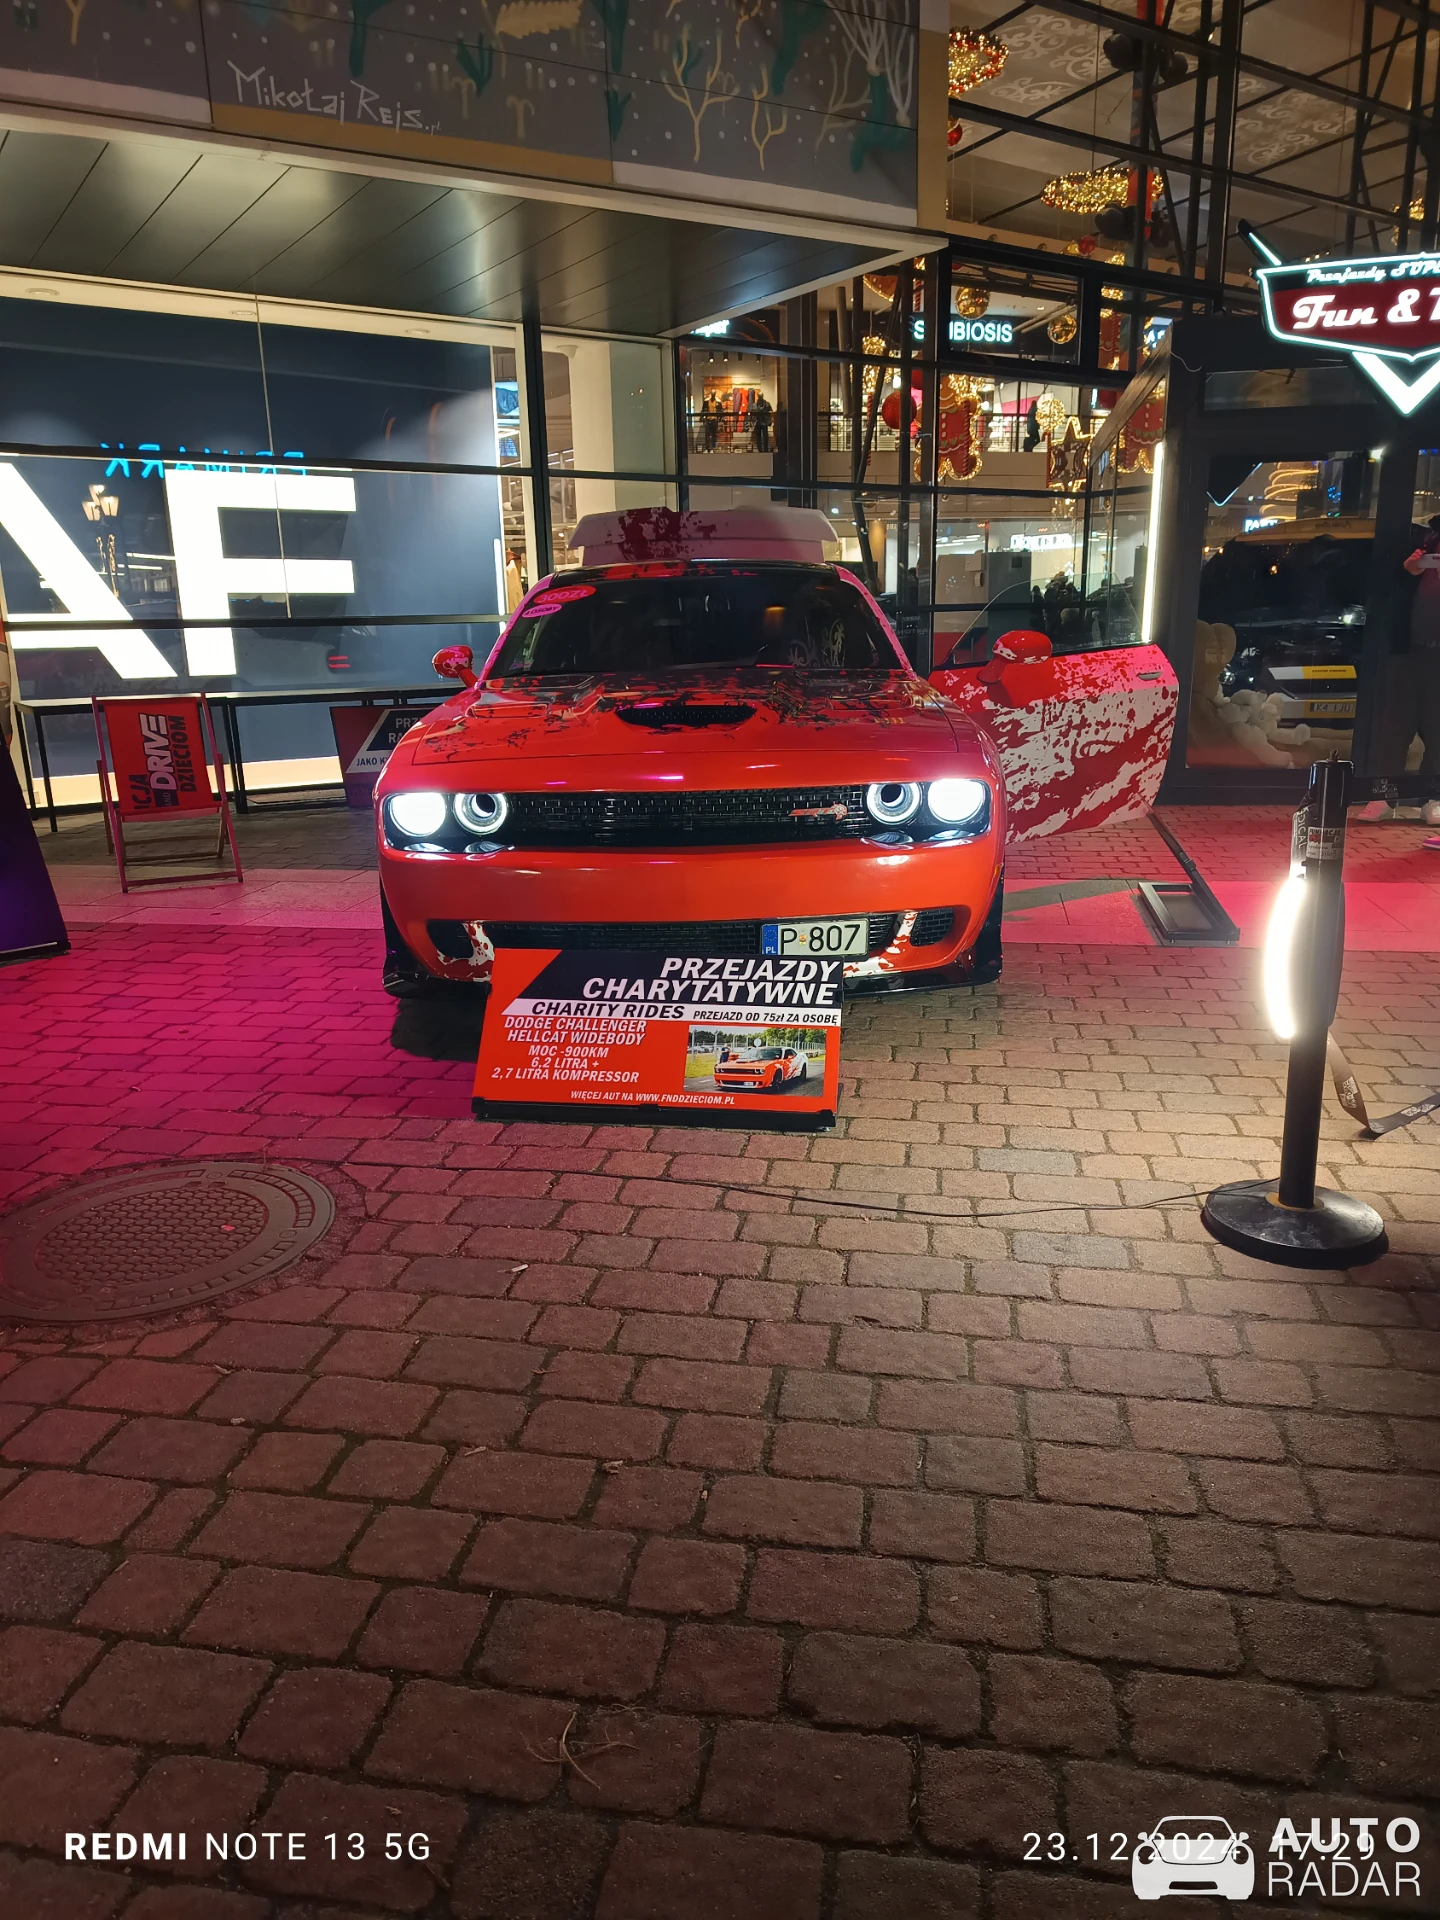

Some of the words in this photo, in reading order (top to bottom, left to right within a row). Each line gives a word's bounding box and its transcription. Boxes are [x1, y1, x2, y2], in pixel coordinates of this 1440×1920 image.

[1293, 294, 1378, 329] Fun
[1387, 288, 1421, 323] &
[913, 320, 1013, 342] SBIOSIS
[395, 717, 423, 729] PRZ
[139, 712, 178, 791] DRIVE
[168, 715, 197, 792] DZIECIOM
[356, 757, 378, 767] JAKO
[765, 946, 776, 954] PL
[780, 928, 798, 955] P
[809, 924, 861, 952] 807
[660, 957, 841, 982] PRZEJAZDY
[582, 977, 838, 1005] CHARYTATYWNE
[531, 1002, 620, 1017] CHARITY
[623, 1004, 685, 1019] RIDES
[693, 1010, 743, 1021] PRZEJAZD
[745, 1012, 760, 1022] OD
[763, 1013, 784, 1022] 75zł
[786, 1014, 800, 1023] ZA
[802, 1014, 838, 1026] OSOBĘ
[504, 1016, 552, 1030] DODGE
[555, 1018, 647, 1033] CHALLENGER
[507, 1030, 569, 1043] HELLCAT
[570, 1032, 646, 1046] WIDEBODY
[528, 1045, 558, 1057] MOC
[560, 1046, 609, 1058] -900KM
[531, 1057, 552, 1069] 6,2
[554, 1058, 588, 1069] LITRA
[592, 1060, 600, 1068] +
[491, 1067, 513, 1080] 2,7
[515, 1068, 549, 1080] LITRA
[552, 1069, 640, 1083] KOMPRESSOR
[570, 1090, 602, 1101] WIĘCEJ
[602, 1092, 621, 1100] AUT
[622, 1092, 633, 1101] NA
[635, 1093, 735, 1105] WWW.FNDDZIECIOM.PL
